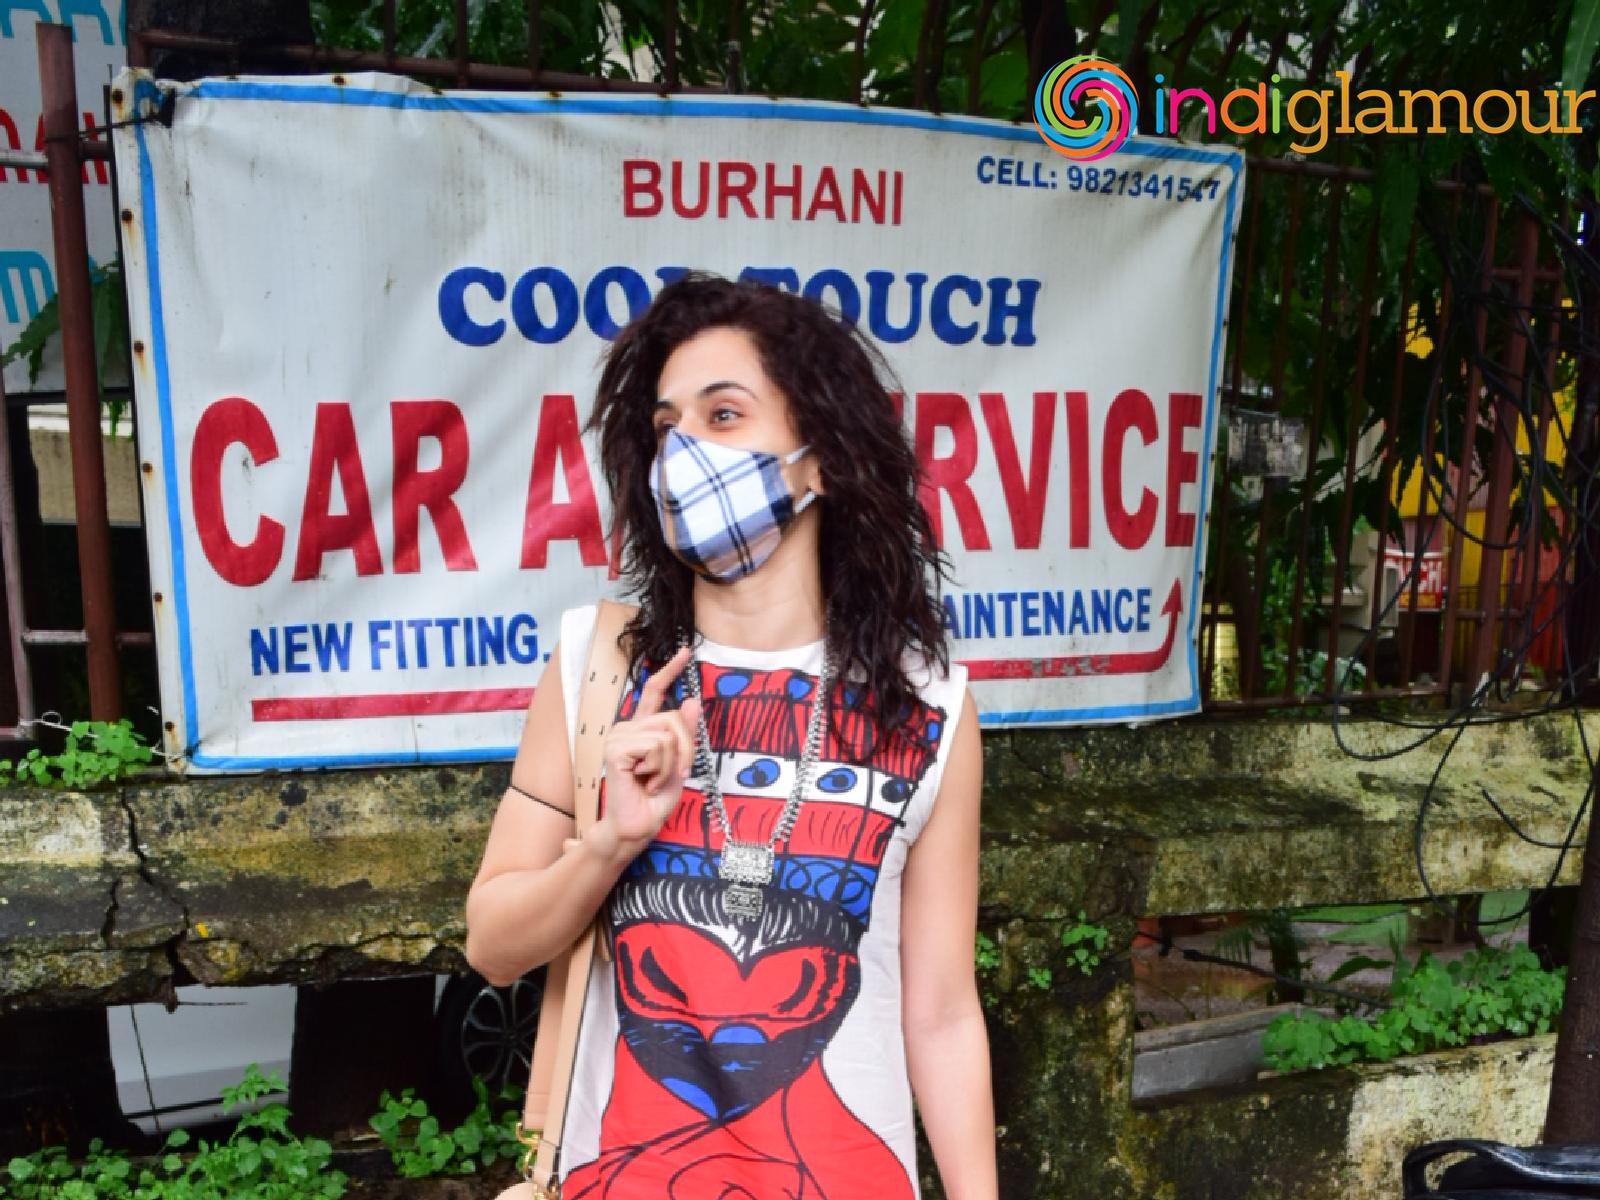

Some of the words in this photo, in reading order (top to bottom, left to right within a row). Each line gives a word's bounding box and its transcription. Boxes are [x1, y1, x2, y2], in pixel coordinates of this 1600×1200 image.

[623, 159, 903, 226] BURHANI
[976, 155, 1057, 189] CELL:
[1066, 164, 1221, 202] 9821341547
[190, 395, 477, 588] CAR
[889, 388, 1203, 552] RVICE
[942, 586, 1152, 640] AINTENANCE
[250, 621, 353, 676] NEW
